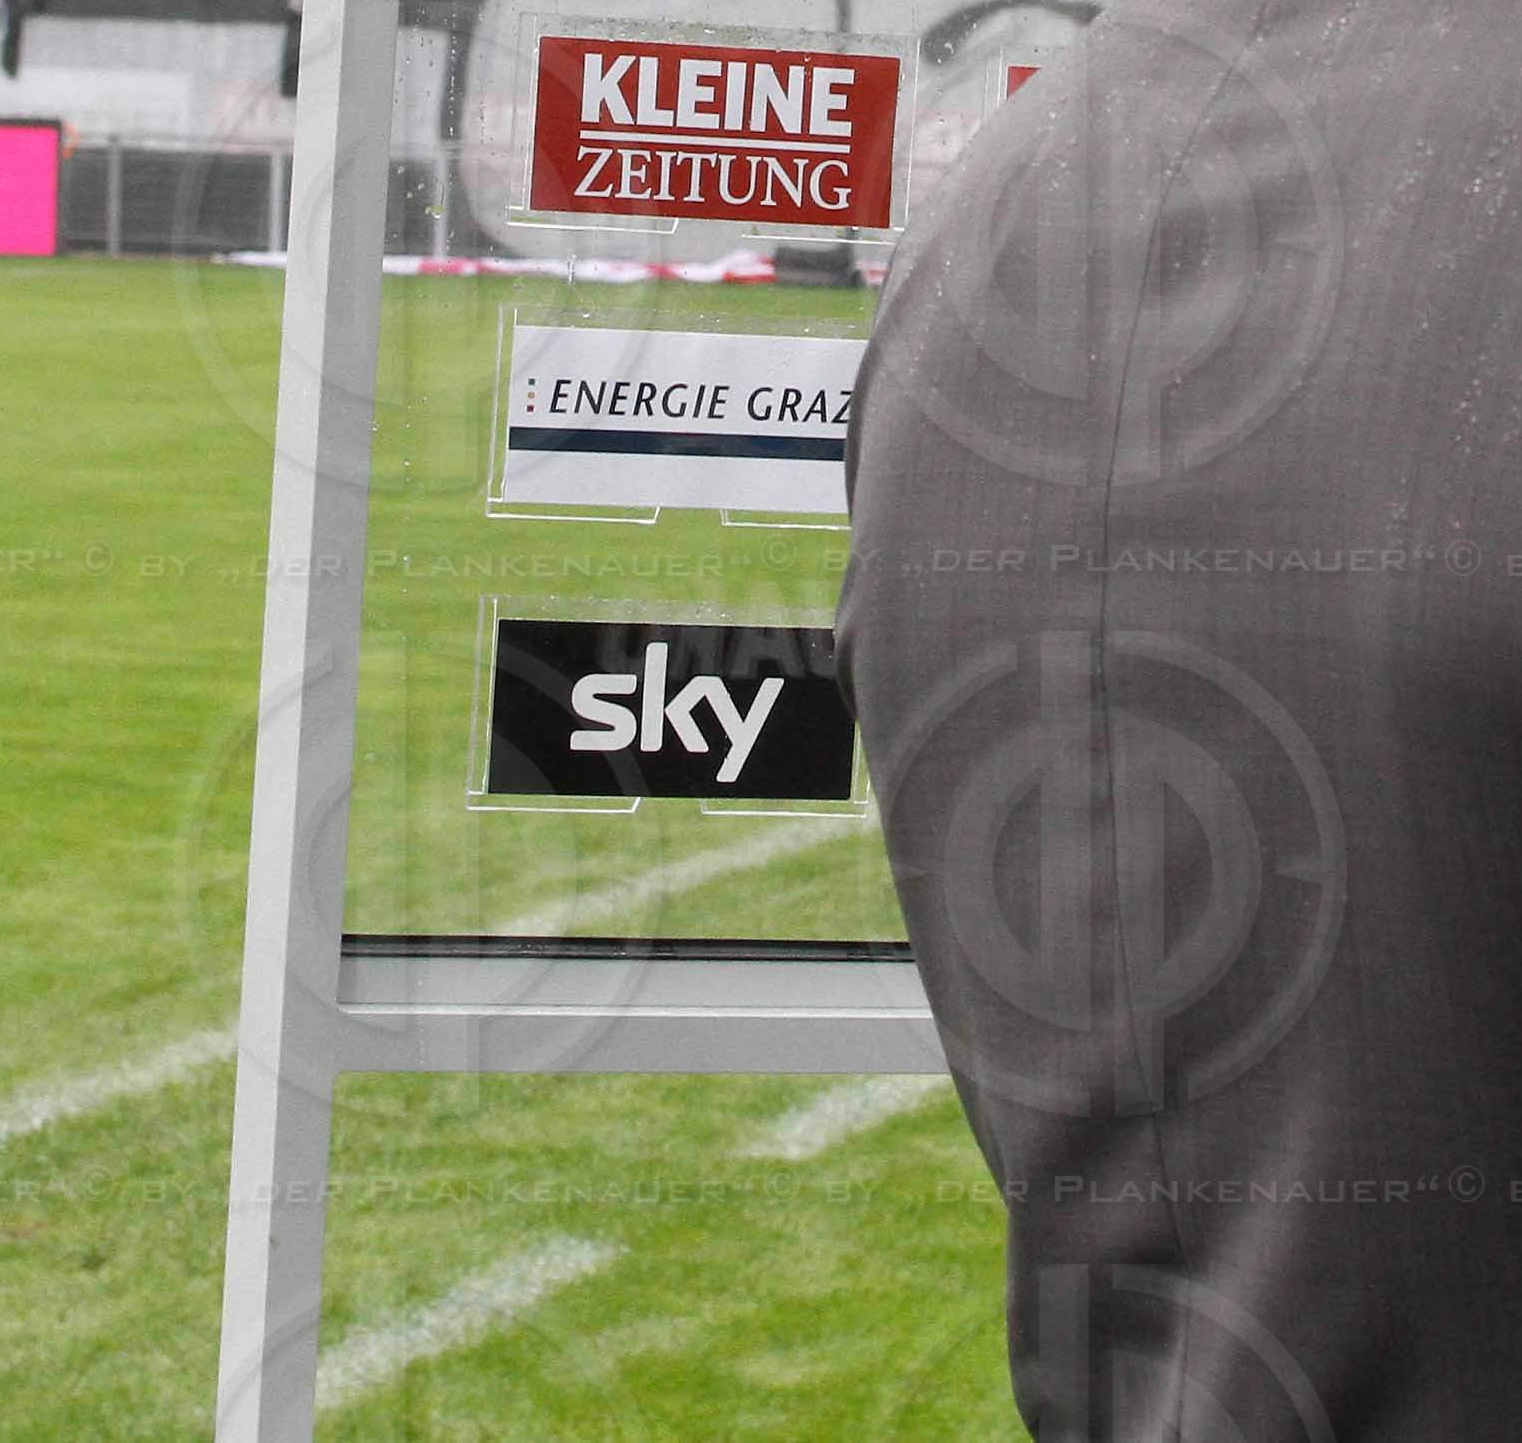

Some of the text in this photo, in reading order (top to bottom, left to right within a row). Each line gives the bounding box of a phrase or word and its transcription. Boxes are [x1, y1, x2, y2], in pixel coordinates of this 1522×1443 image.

[580, 52, 855, 138] KLEINE
[574, 145, 852, 210] ZEITUNG
[549, 379, 854, 424] ENERGIE GRAZ
[569, 642, 785, 783] sky
